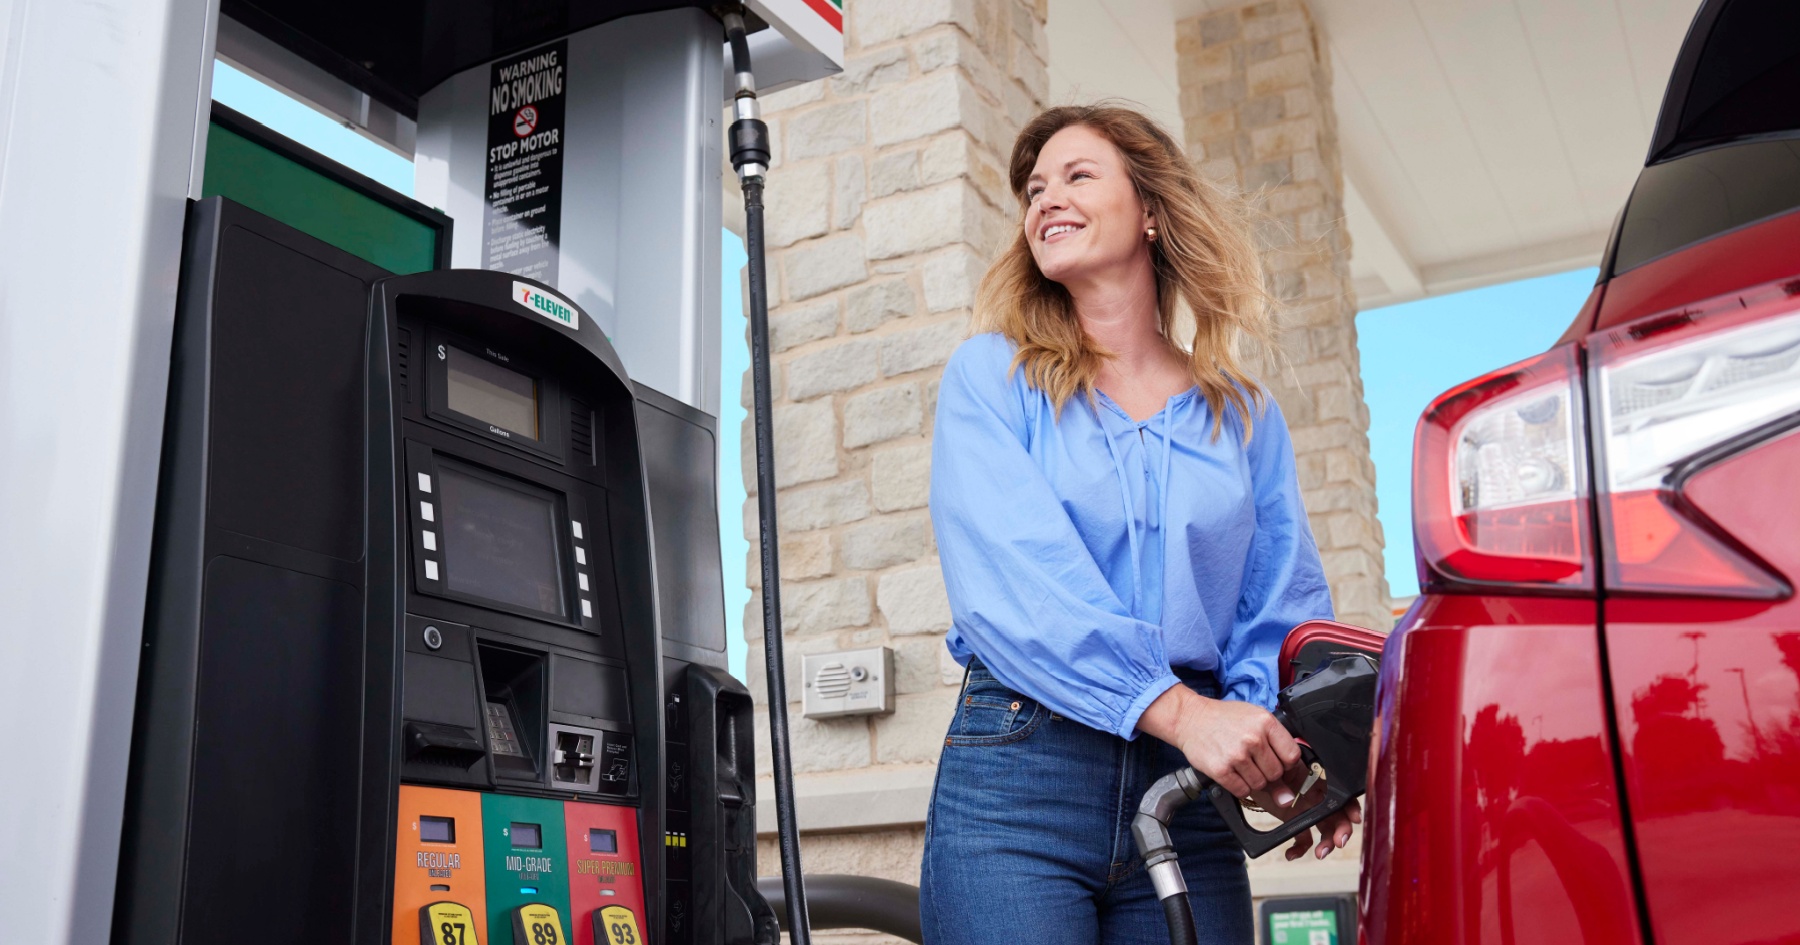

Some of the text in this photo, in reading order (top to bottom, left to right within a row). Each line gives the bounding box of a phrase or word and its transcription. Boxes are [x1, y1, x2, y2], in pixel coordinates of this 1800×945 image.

[500, 51, 557, 82] WARNING
[492, 66, 562, 115] NO SMOKING
[490, 128, 559, 163] STOP MOTOR
[502, 158, 521, 169] unlawful
[521, 155, 530, 164] and
[530, 149, 551, 162] dangerous
[551, 146, 557, 155] to
[512, 164, 529, 175] gasoline
[530, 160, 538, 169] into
[492, 176, 518, 188] unapproved
[492, 181, 536, 199] No filling of portable
[492, 195, 514, 207] containers
[535, 185, 549, 194] motor
[502, 211, 523, 223] container
[524, 209, 530, 217] on
[530, 204, 546, 216] ground
[524, 223, 546, 238] electricity
[437, 344, 446, 361] $
[490, 425, 510, 438] Gallons
[412, 822, 417, 831] $
[503, 828, 508, 837] $
[417, 851, 460, 869] REGULAR
[506, 855, 552, 873] MID-GRADE
[577, 860, 634, 876] SUPER PREMIUM
[441, 922, 465, 945] 87
[532, 923, 557, 945] 89
[612, 923, 635, 945] 93
